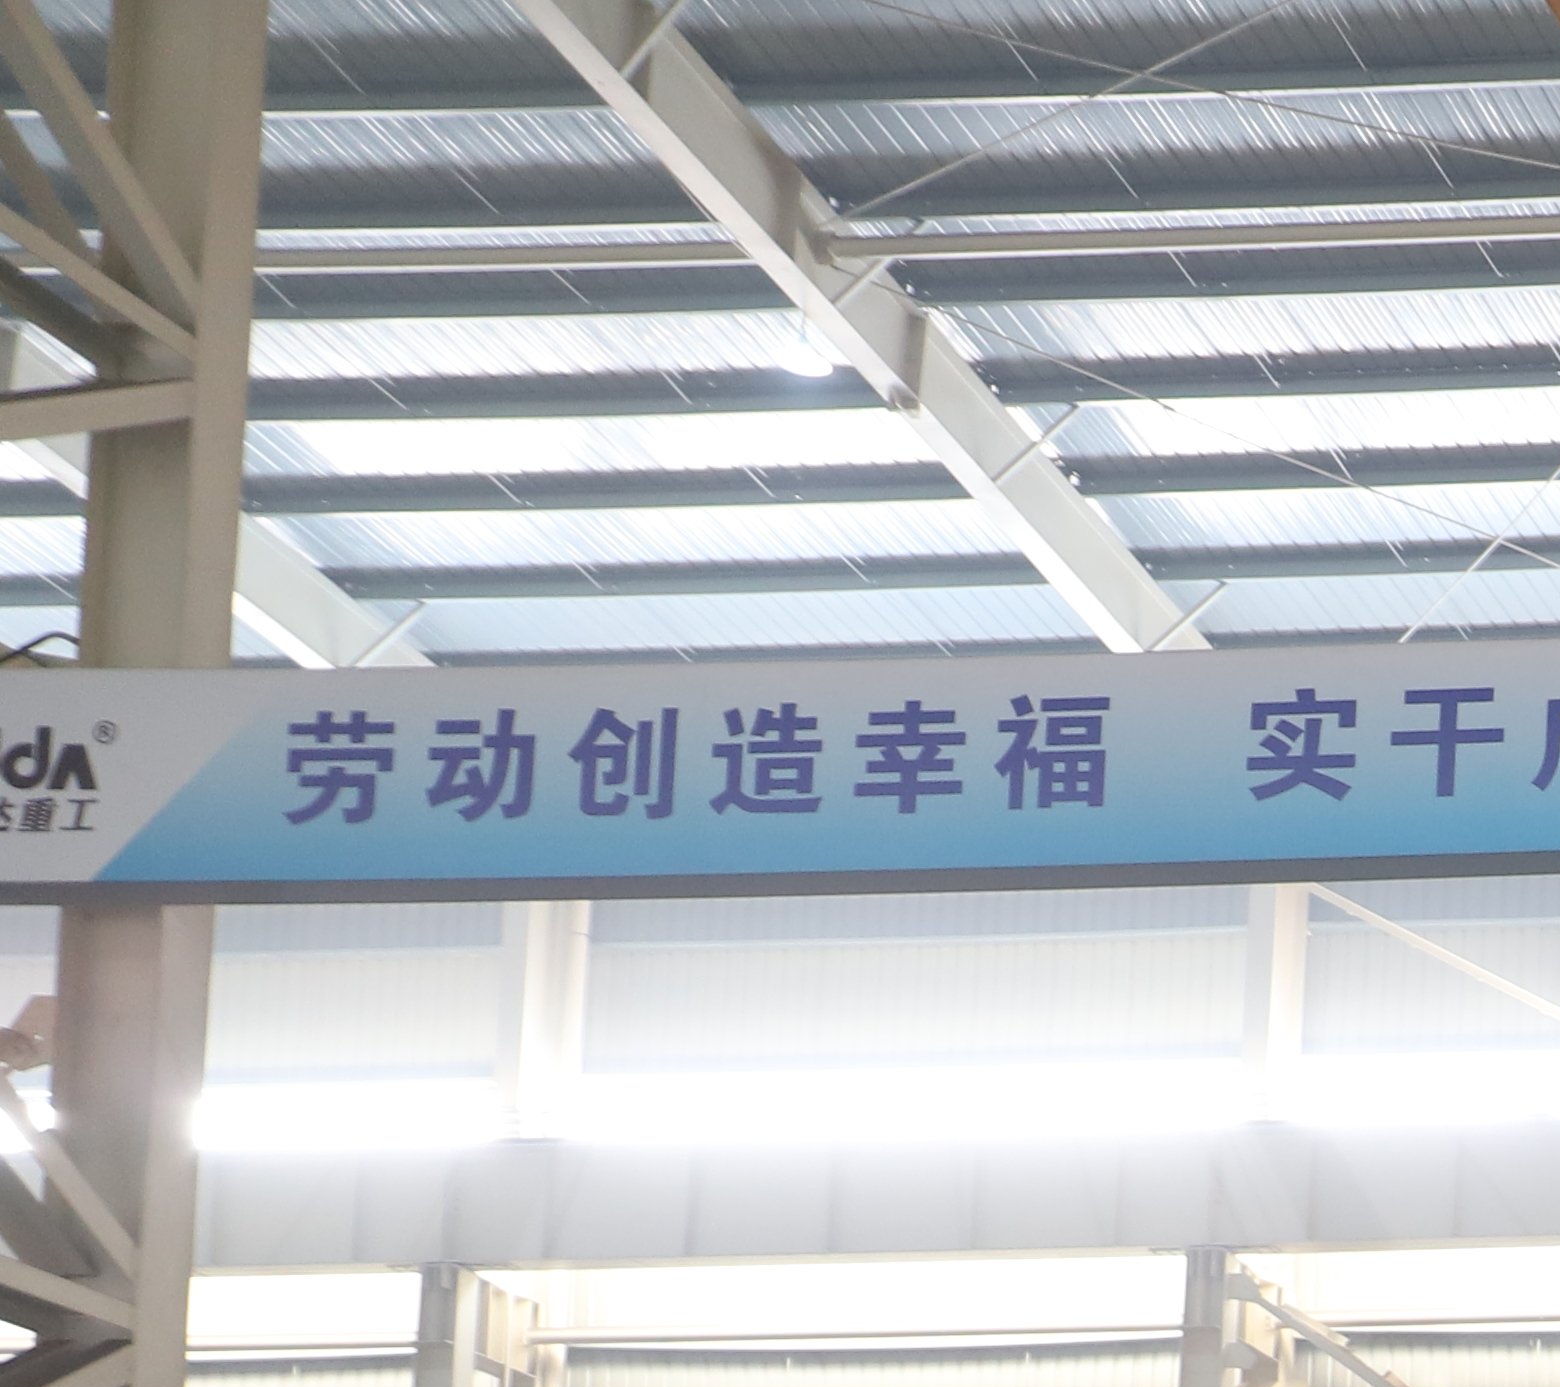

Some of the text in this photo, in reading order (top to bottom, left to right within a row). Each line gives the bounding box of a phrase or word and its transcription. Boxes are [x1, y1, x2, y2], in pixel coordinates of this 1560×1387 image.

[284, 694, 1113, 826] 劳动创造幸福
